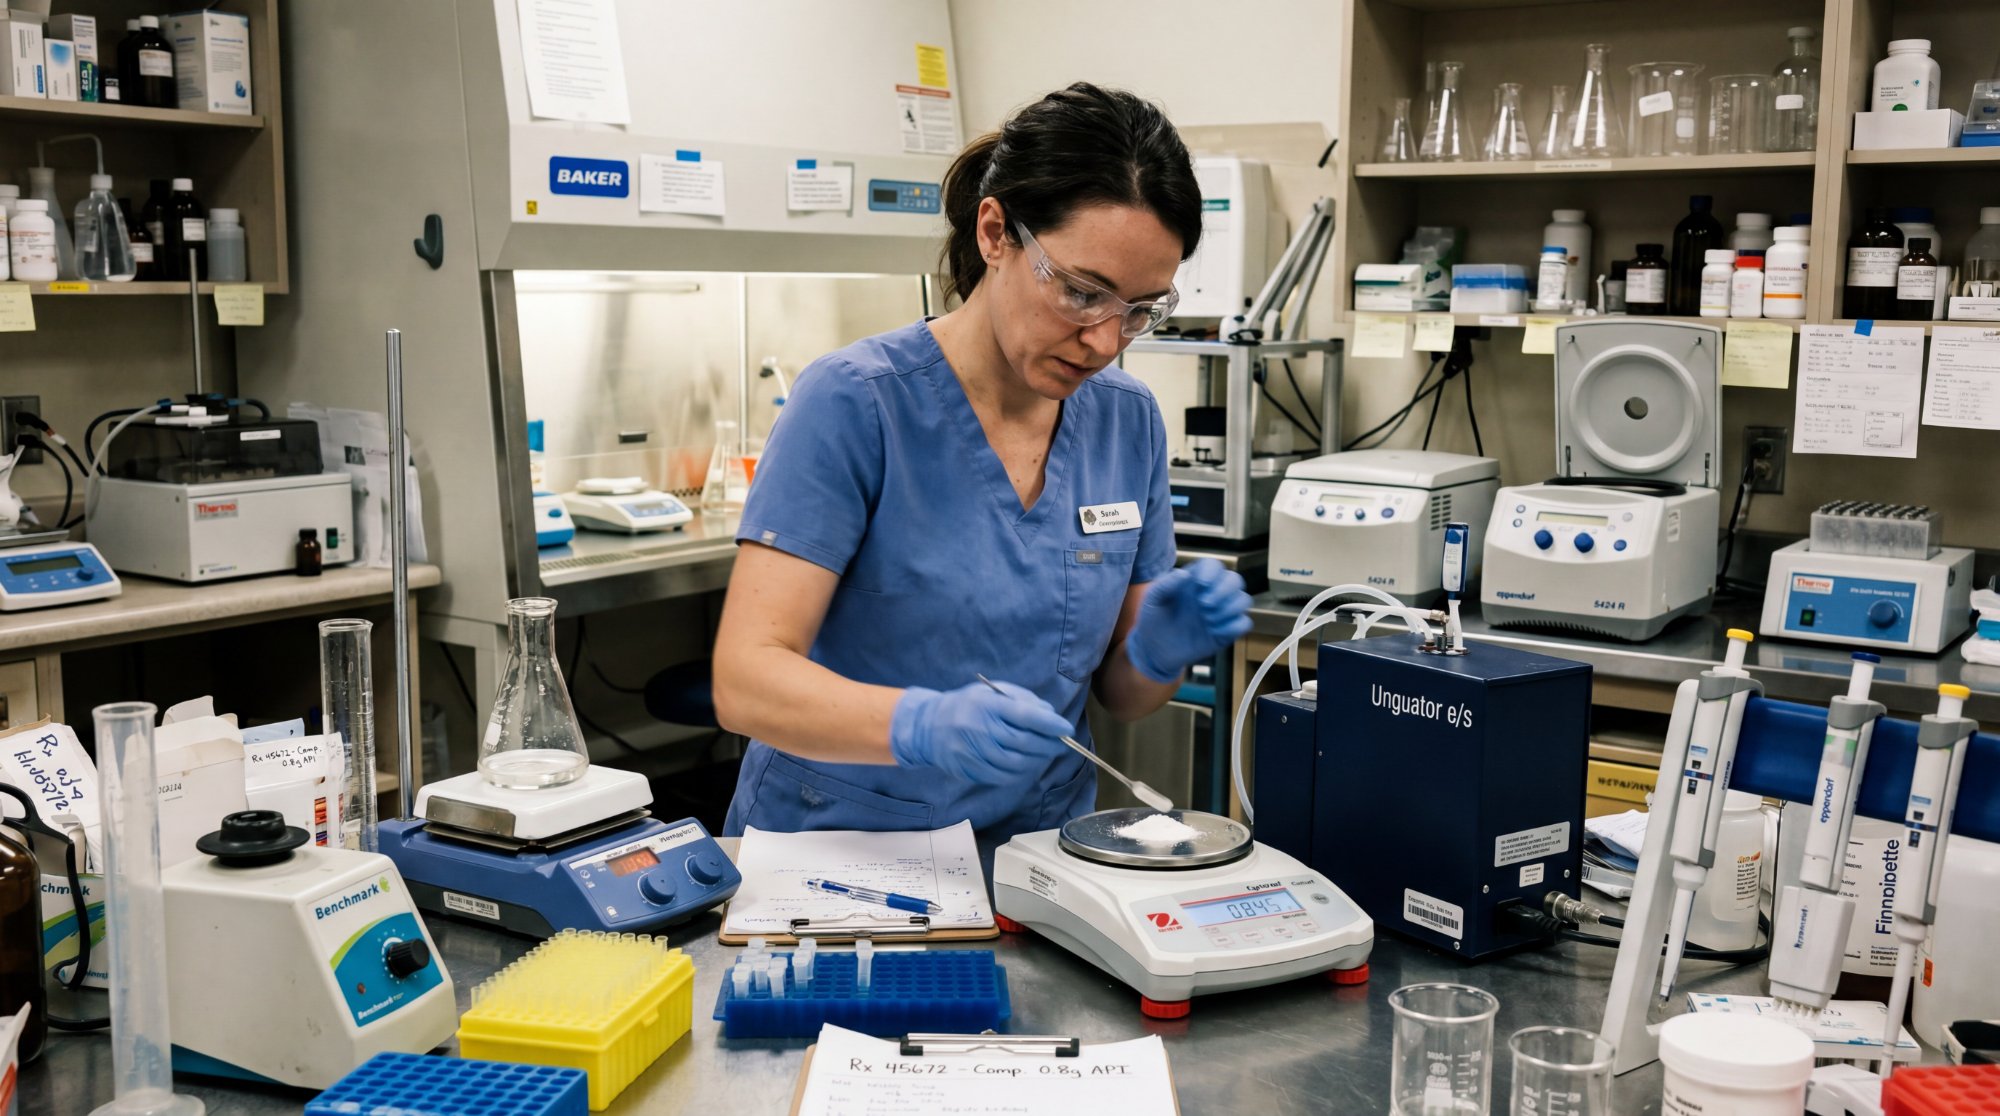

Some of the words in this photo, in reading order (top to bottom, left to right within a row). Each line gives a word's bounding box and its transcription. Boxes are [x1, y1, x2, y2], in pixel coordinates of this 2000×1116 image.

[557, 169, 622, 187] BAKER
[1593, 600, 1616, 609] 5424
[1617, 602, 1626, 611] R
[1372, 684, 1443, 721] Unguator
[1447, 703, 1473, 728] e/s
[1820, 778, 1834, 824] eppendorf
[315, 883, 380, 921] Benchmark
[850, 1058, 873, 1073] Rx
[886, 1063, 947, 1075] 45672
[973, 1064, 1027, 1077] Comp.
[1039, 1065, 1082, 1078] 0.8g
[1091, 1064, 1133, 1075] API
